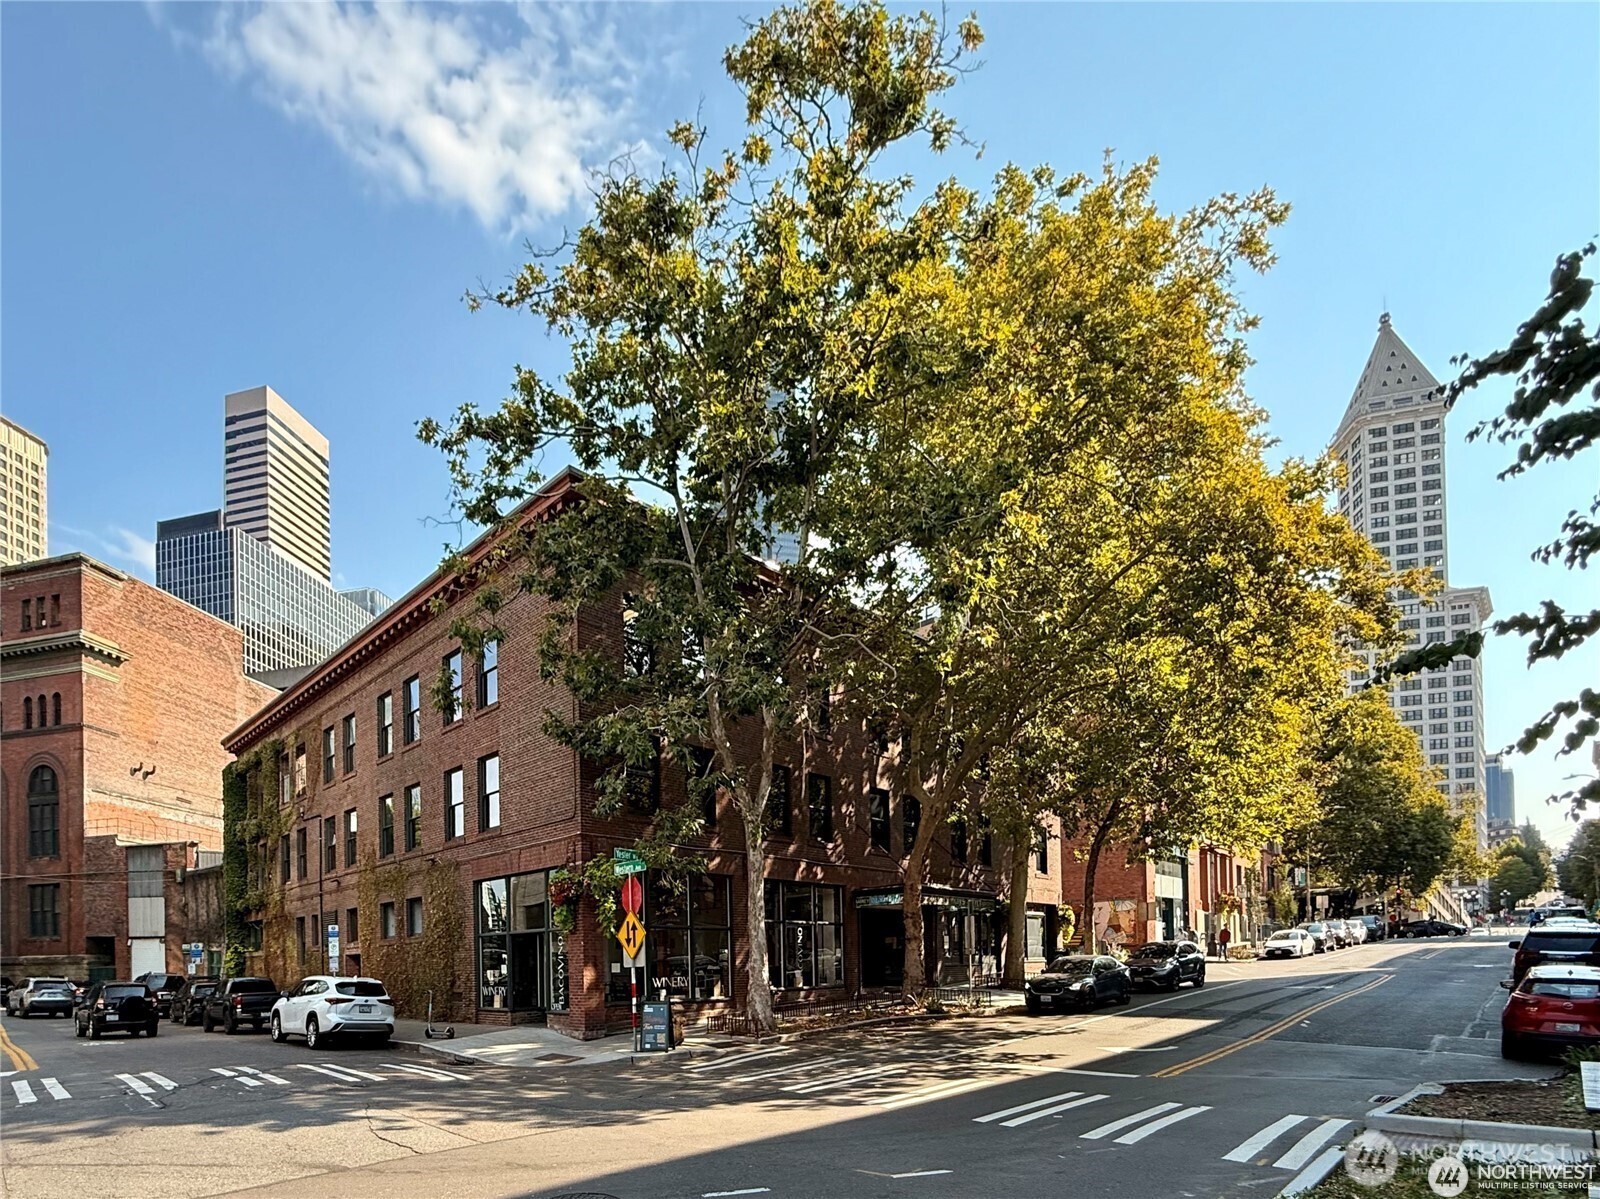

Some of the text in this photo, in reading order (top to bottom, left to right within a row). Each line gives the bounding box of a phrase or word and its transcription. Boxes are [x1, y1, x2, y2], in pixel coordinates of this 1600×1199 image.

[615, 849, 631, 859] Yesler
[615, 863, 633, 874] Western
[652, 976, 689, 988] WINERY
[482, 986, 507, 996] WINERY
